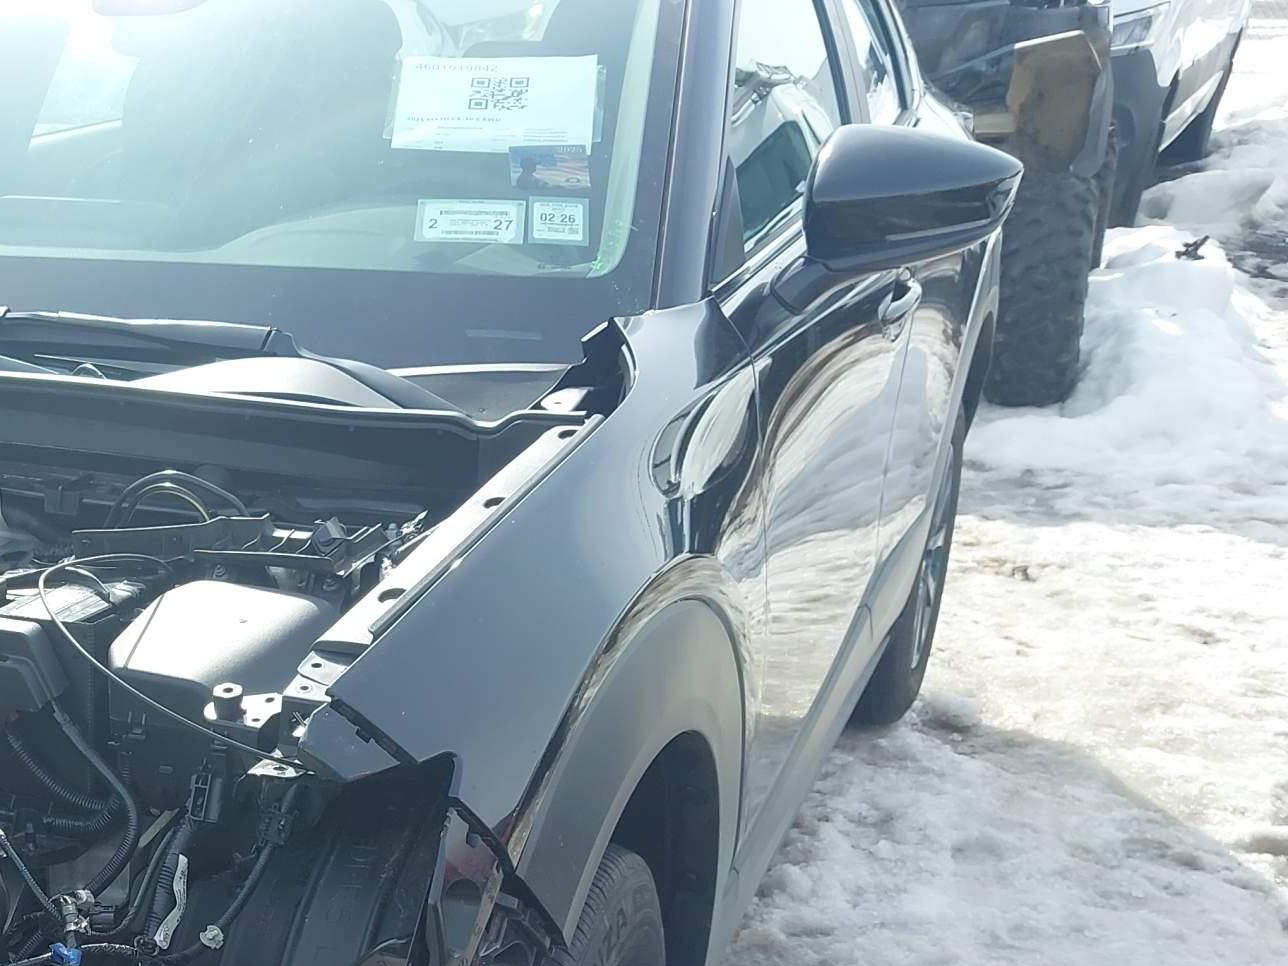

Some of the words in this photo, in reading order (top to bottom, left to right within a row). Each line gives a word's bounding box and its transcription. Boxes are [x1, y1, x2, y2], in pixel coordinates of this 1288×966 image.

[539, 212, 556, 222] 02
[559, 213, 576, 224] 26
[427, 218, 439, 230] 2
[493, 219, 514, 231] 27
